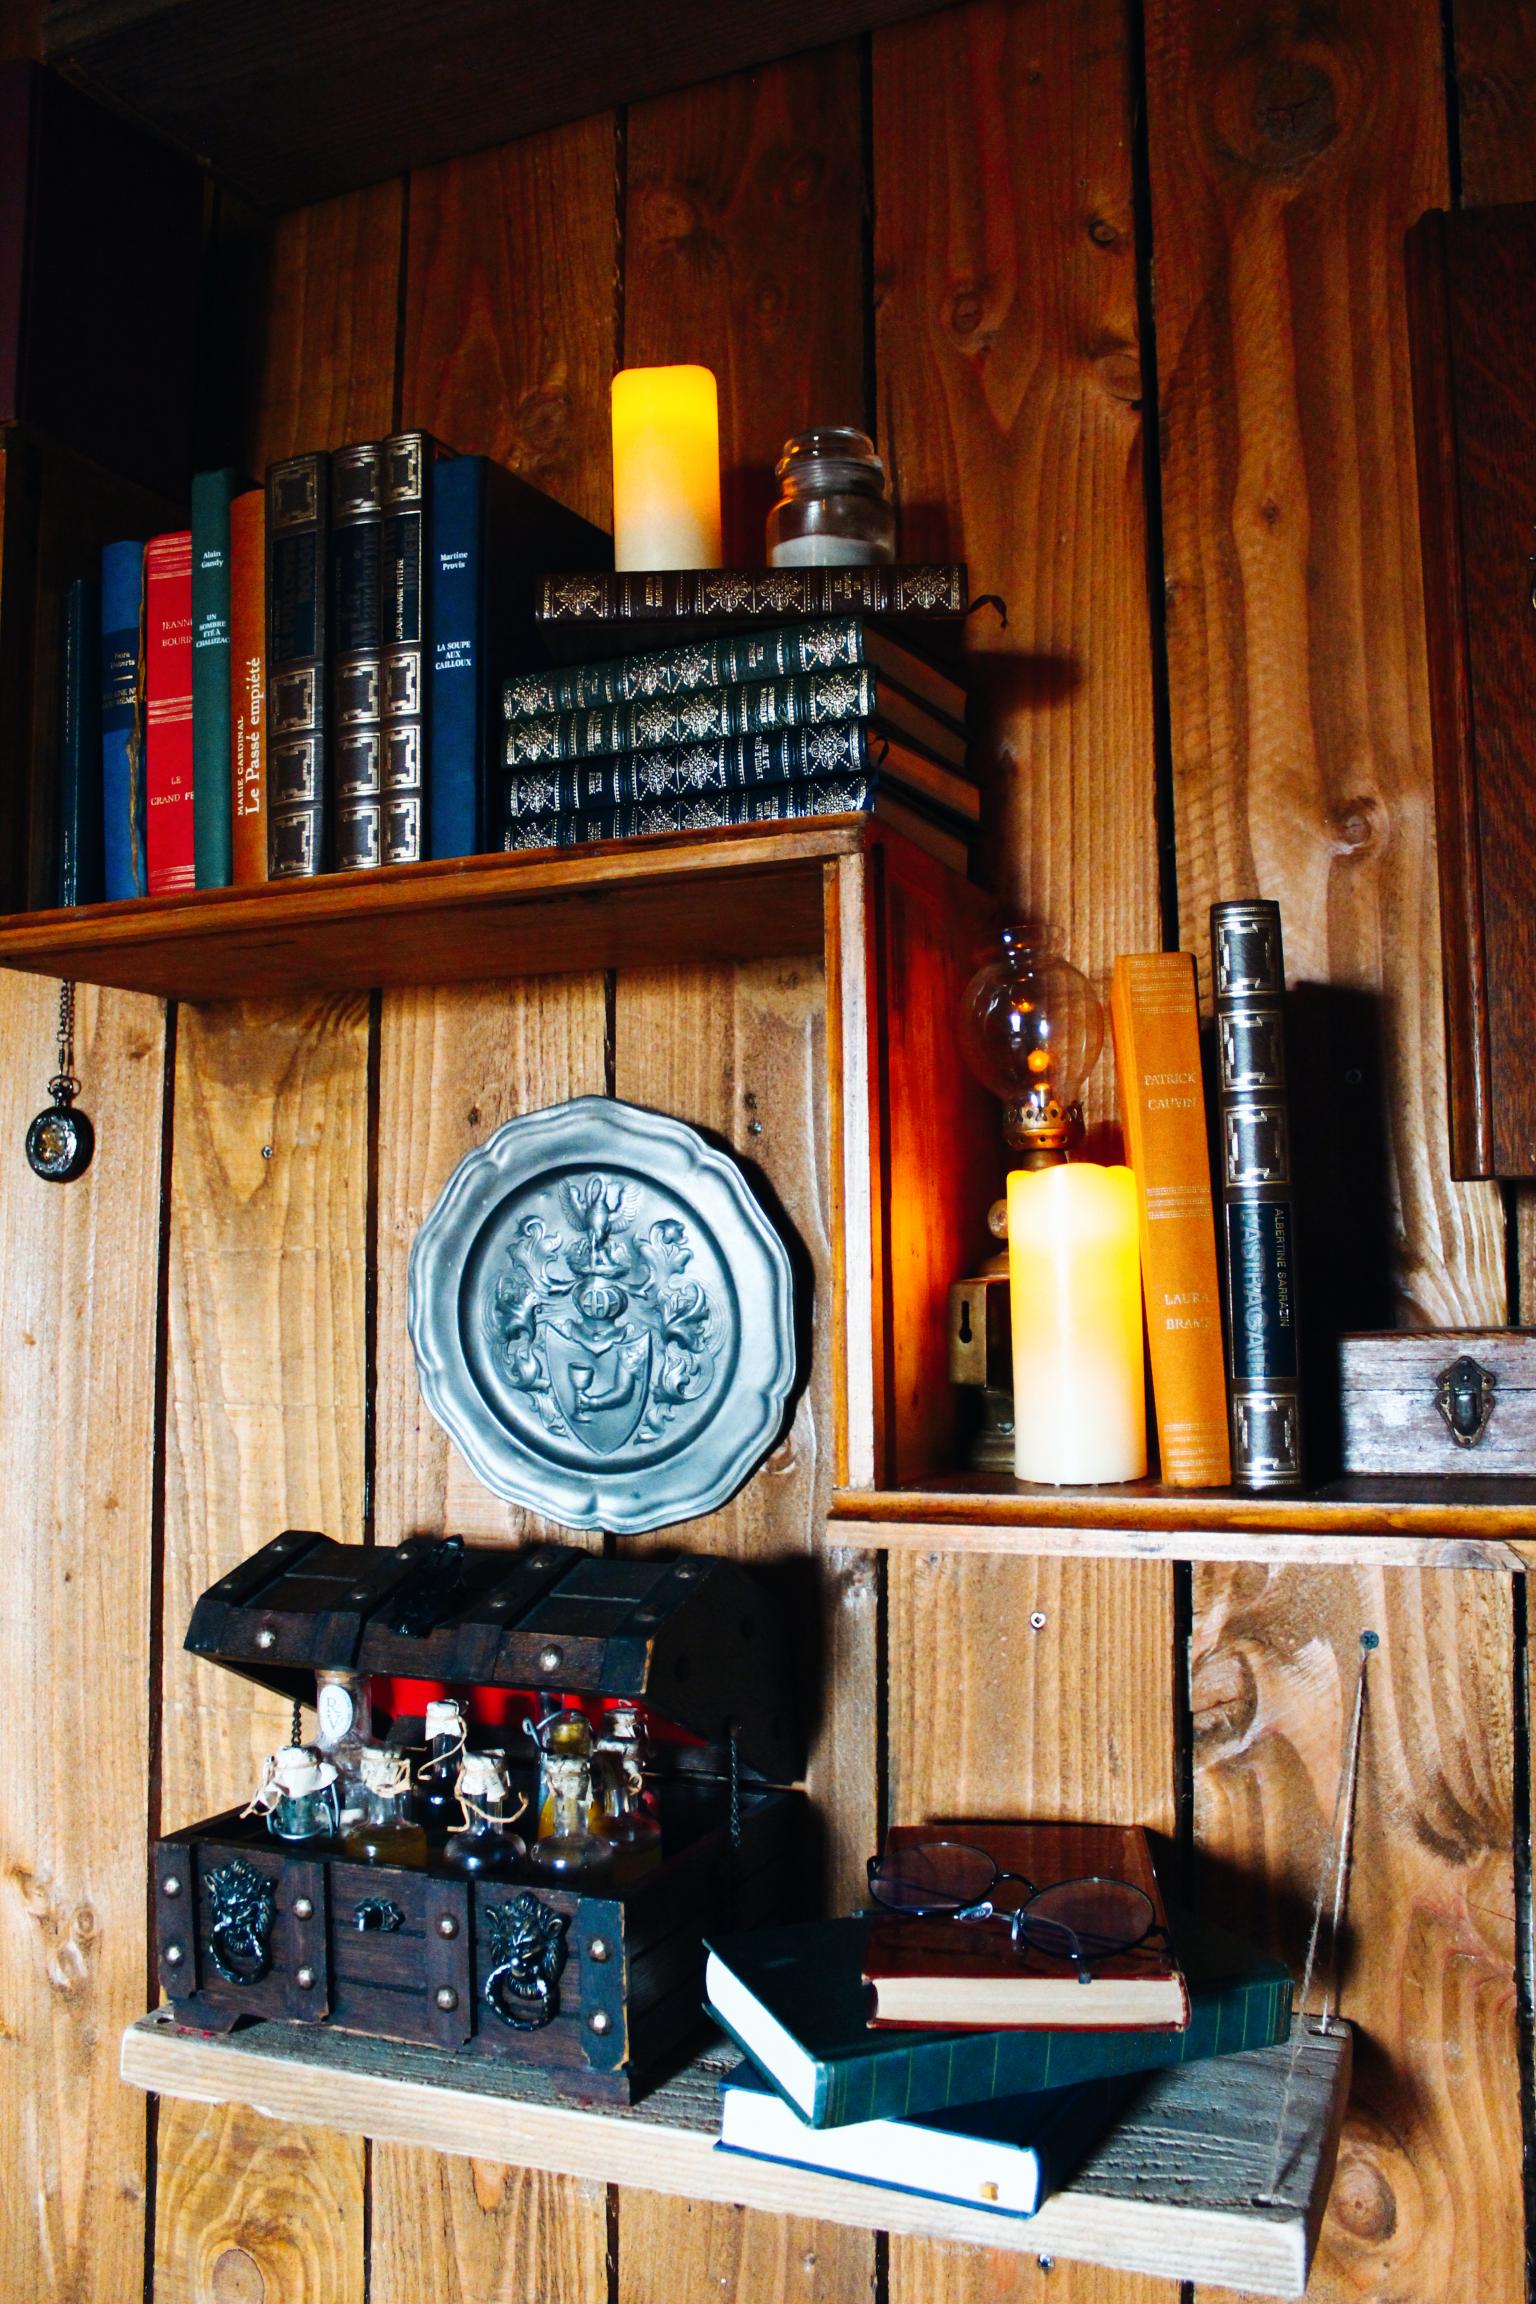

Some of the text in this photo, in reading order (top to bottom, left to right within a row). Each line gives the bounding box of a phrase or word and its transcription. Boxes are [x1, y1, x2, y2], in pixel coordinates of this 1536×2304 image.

[203, 550, 221, 559] Alain
[440, 552, 468, 561] Martine
[201, 559, 224, 568] Gandy
[442, 561, 466, 571] Provis
[863, 571, 872, 606] NAVA
[396, 586, 404, 640] JEAN-MARIE
[162, 619, 192, 632] JEANN
[199, 620, 227, 631] SOMBRE
[436, 640, 472, 652] LA SOUPE
[446, 650, 462, 660] AUX
[435, 658, 472, 670] CAILLOUX
[245, 657, 265, 816] Le Passé empiété
[171, 776, 182, 784] LE
[150, 790, 194, 806] GRAND FE
[1144, 1072, 1196, 1086] PATRICK
[1148, 1097, 1196, 1110] CAUVIN
[1274, 1208, 1290, 1328] ALBERTINE SARRAZIN
[1164, 1292, 1209, 1306] LAURA
